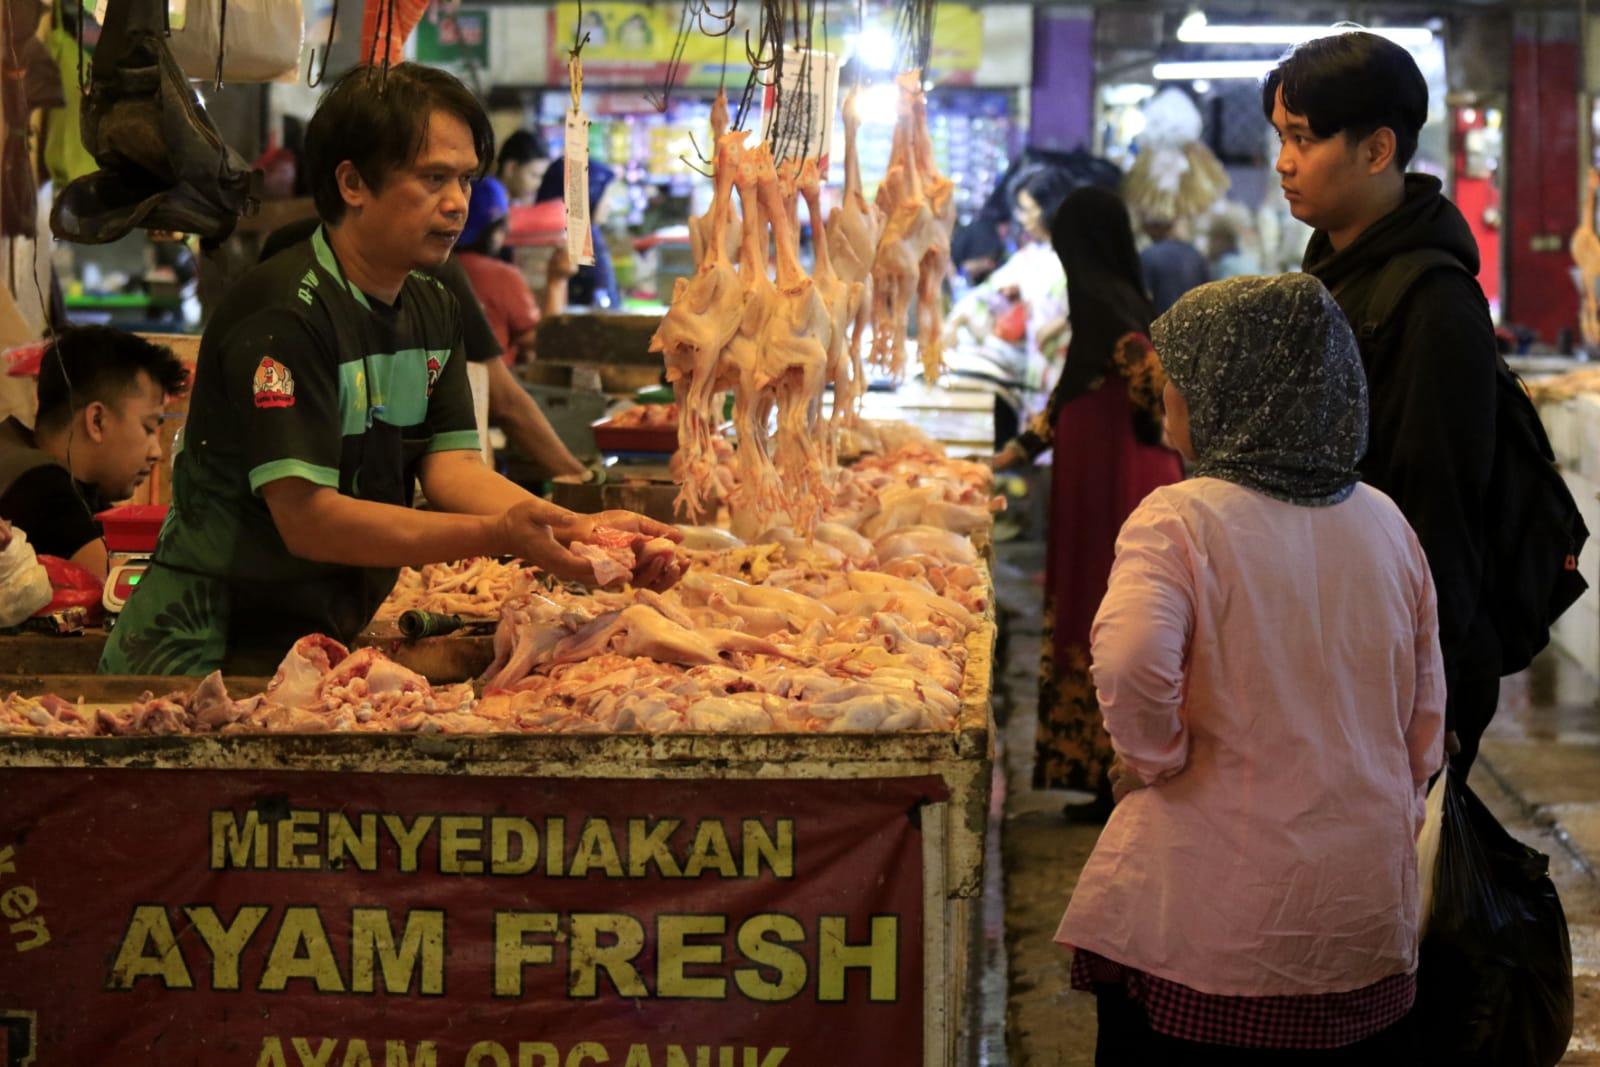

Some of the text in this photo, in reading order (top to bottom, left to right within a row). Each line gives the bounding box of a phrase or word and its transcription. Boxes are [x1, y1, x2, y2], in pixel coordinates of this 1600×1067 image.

[210, 809, 794, 878] MENYEDIAKAN
[107, 904, 898, 1003] AYAM FRESH
[255, 1036, 438, 1067] AYAM
